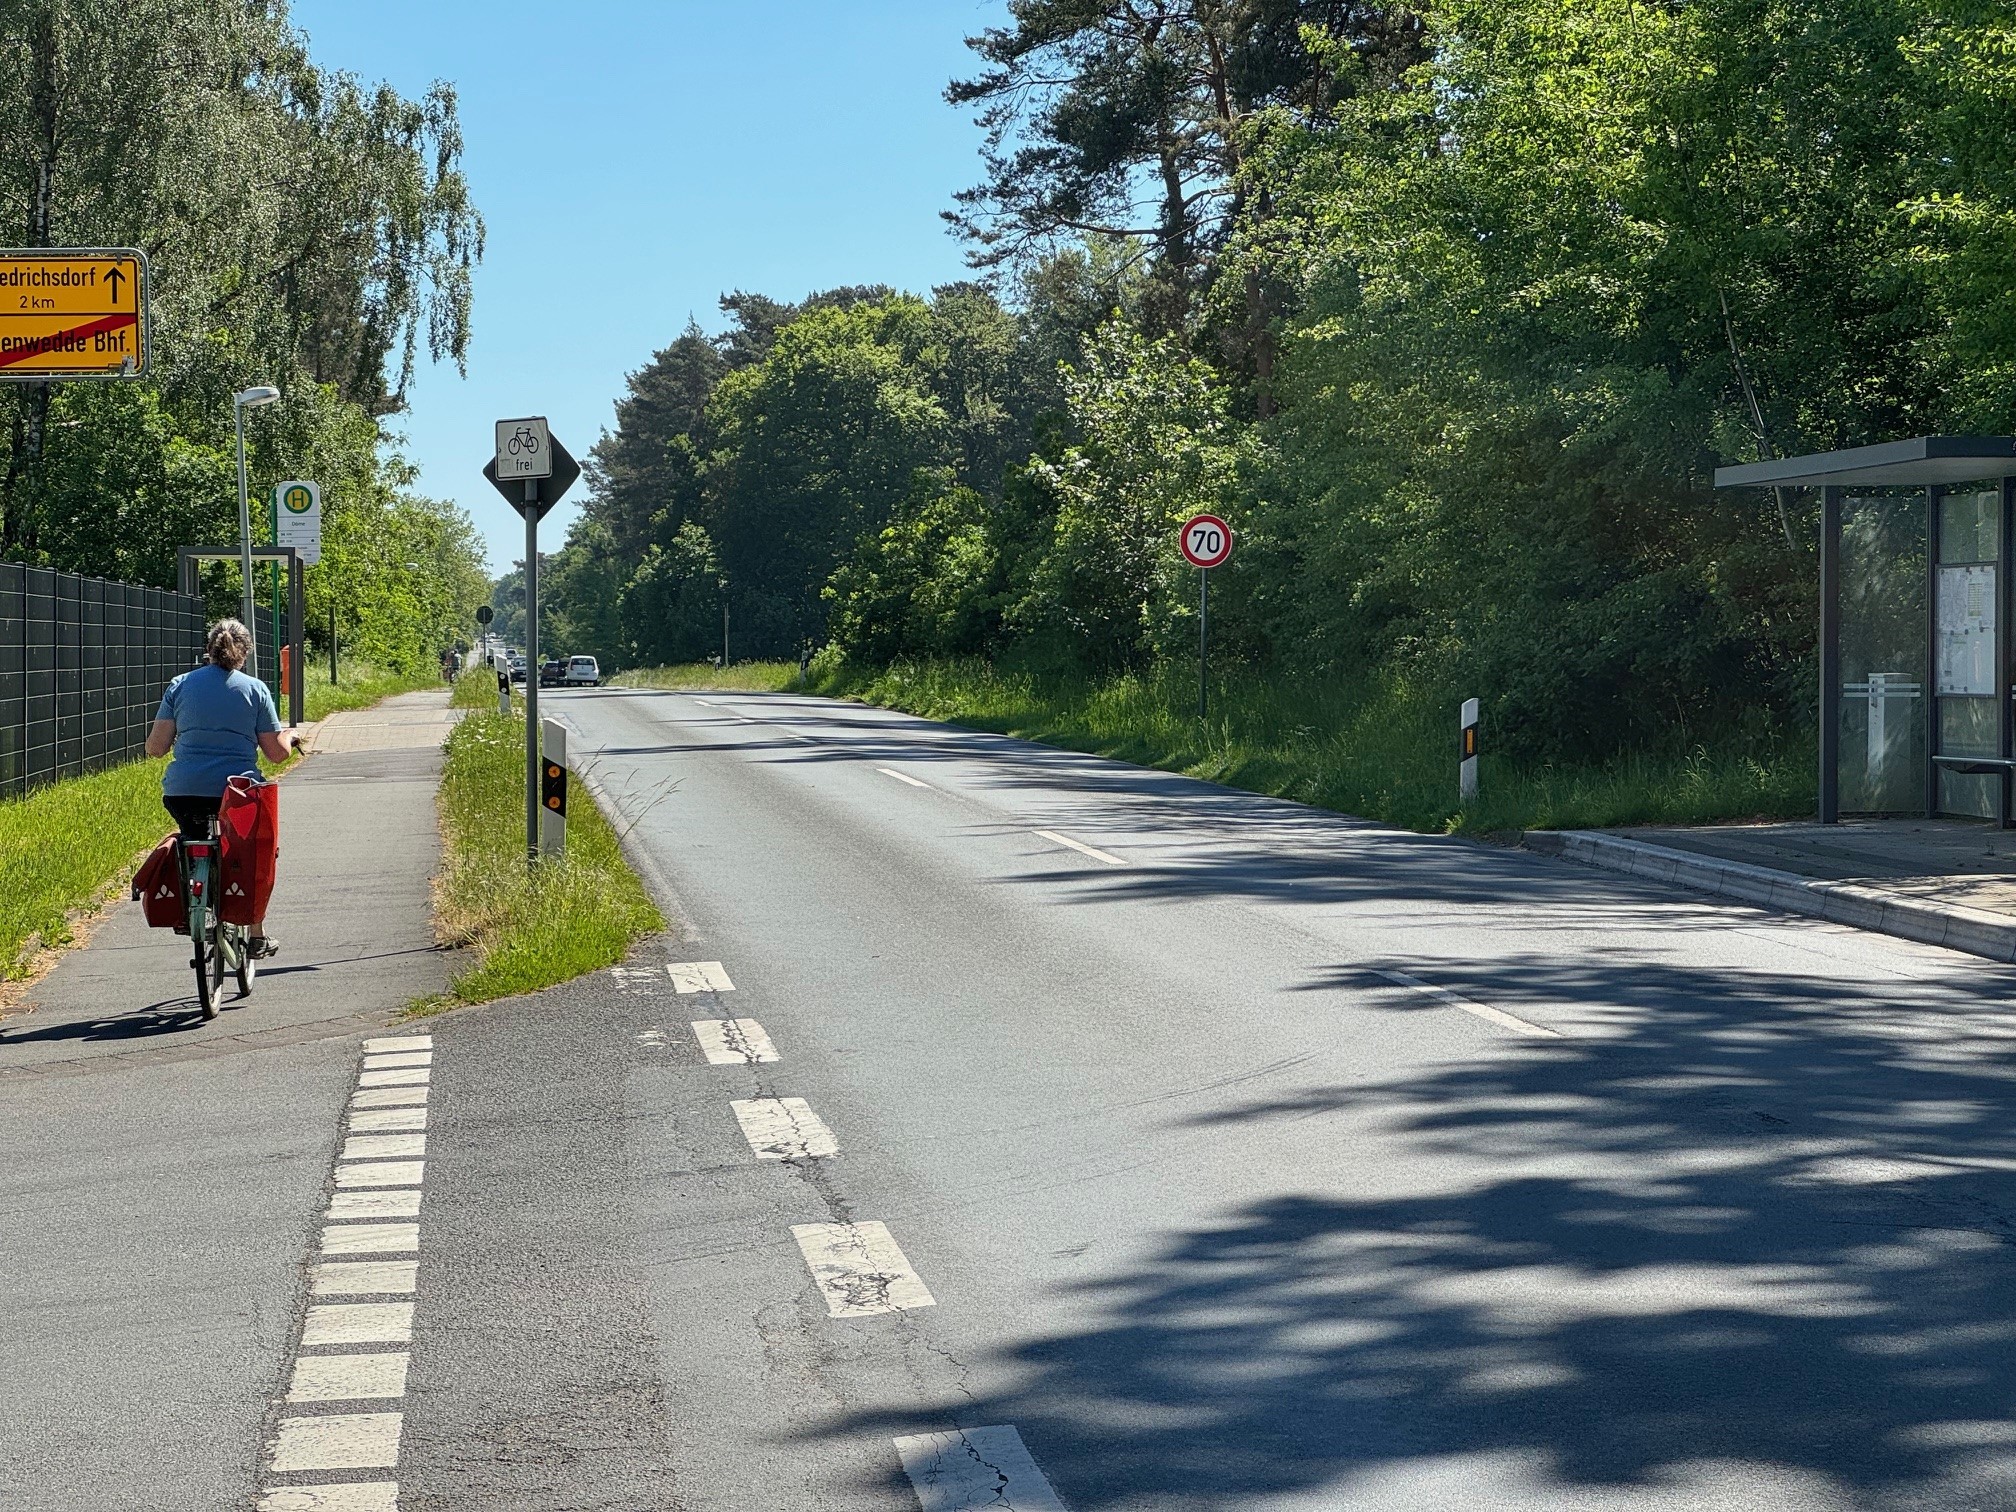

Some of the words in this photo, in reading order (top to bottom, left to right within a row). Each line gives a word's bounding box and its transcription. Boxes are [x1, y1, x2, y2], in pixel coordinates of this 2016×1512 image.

[0, 267, 96, 286] edrichsdorf
[19, 295, 28, 309] 2
[31, 295, 55, 309] km
[1, 330, 87, 352] enwedde
[94, 330, 130, 352] Bhf.
[515, 458, 533, 471] frei
[292, 491, 305, 508] H
[1192, 530, 1220, 553] 70
